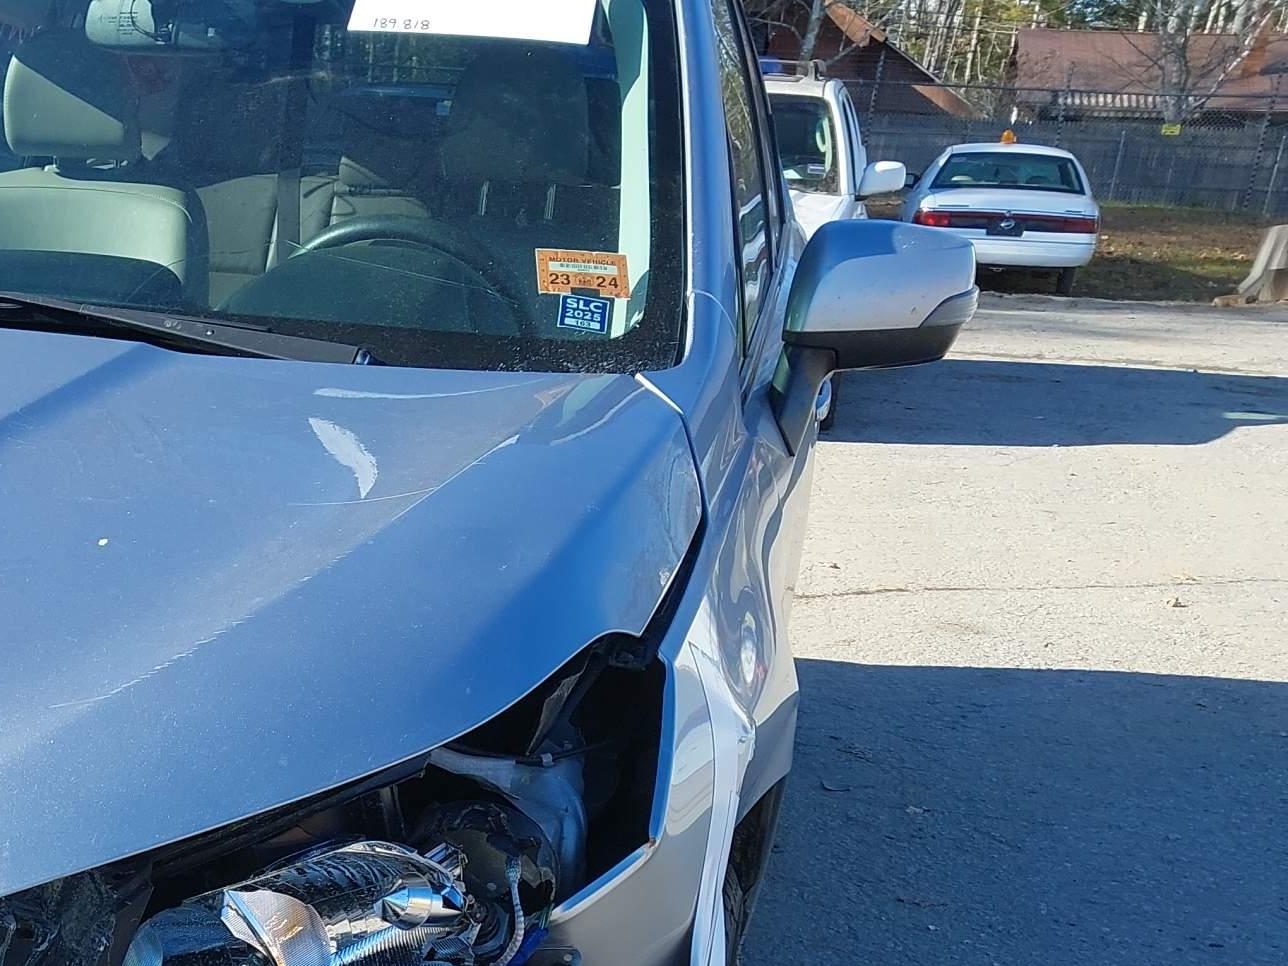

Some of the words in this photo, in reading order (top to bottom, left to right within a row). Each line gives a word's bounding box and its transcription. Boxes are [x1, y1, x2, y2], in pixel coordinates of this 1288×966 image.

[549, 273, 570, 285] 23
[596, 276, 618, 288] 24
[566, 298, 603, 312] SLC
[565, 309, 601, 321] 2025
